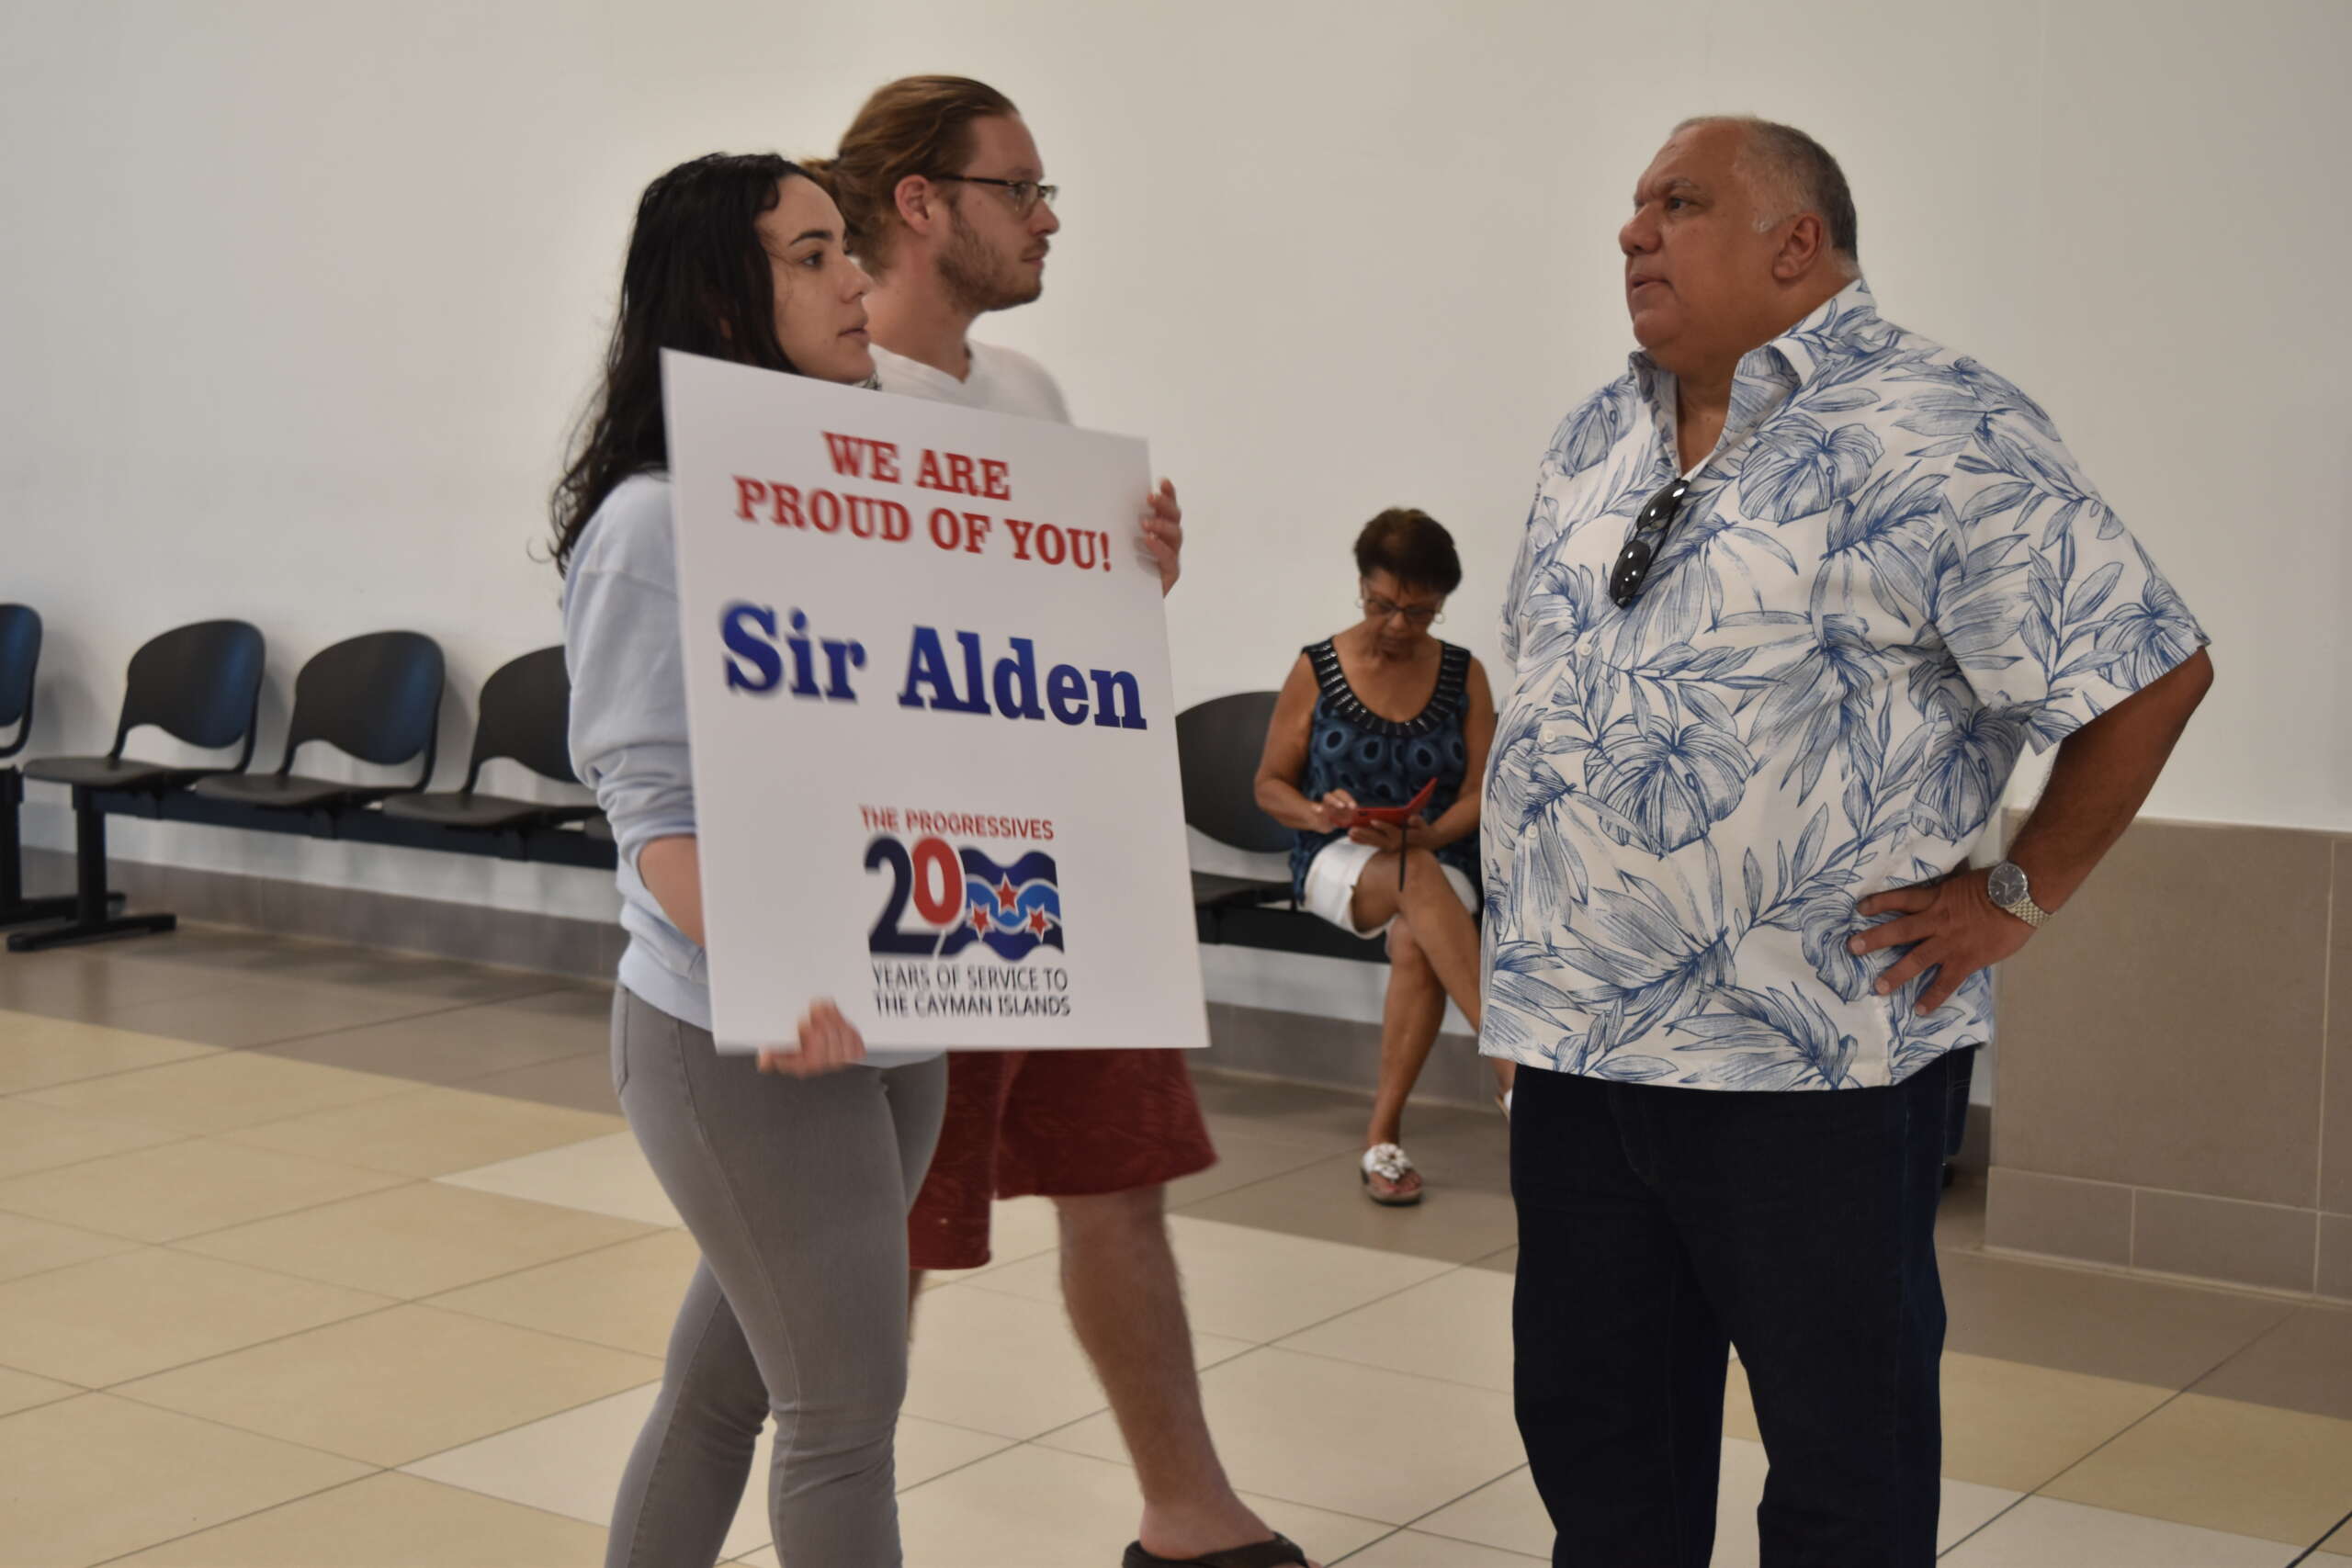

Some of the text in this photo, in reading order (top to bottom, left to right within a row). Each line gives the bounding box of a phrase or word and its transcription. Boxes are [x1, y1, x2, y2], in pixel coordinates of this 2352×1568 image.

[822, 431, 1012, 501] WE ARE
[732, 474, 1111, 571] PROUD OF YOU!
[720, 600, 1148, 730] Sir Alden
[859, 804, 1054, 840] THE PROGRESSIVES
[865, 835, 963, 956] 20
[873, 964, 1068, 993] YEARS OF SERVICE TO
[876, 992, 1070, 1018] THE CAYMAN ISLANDS
